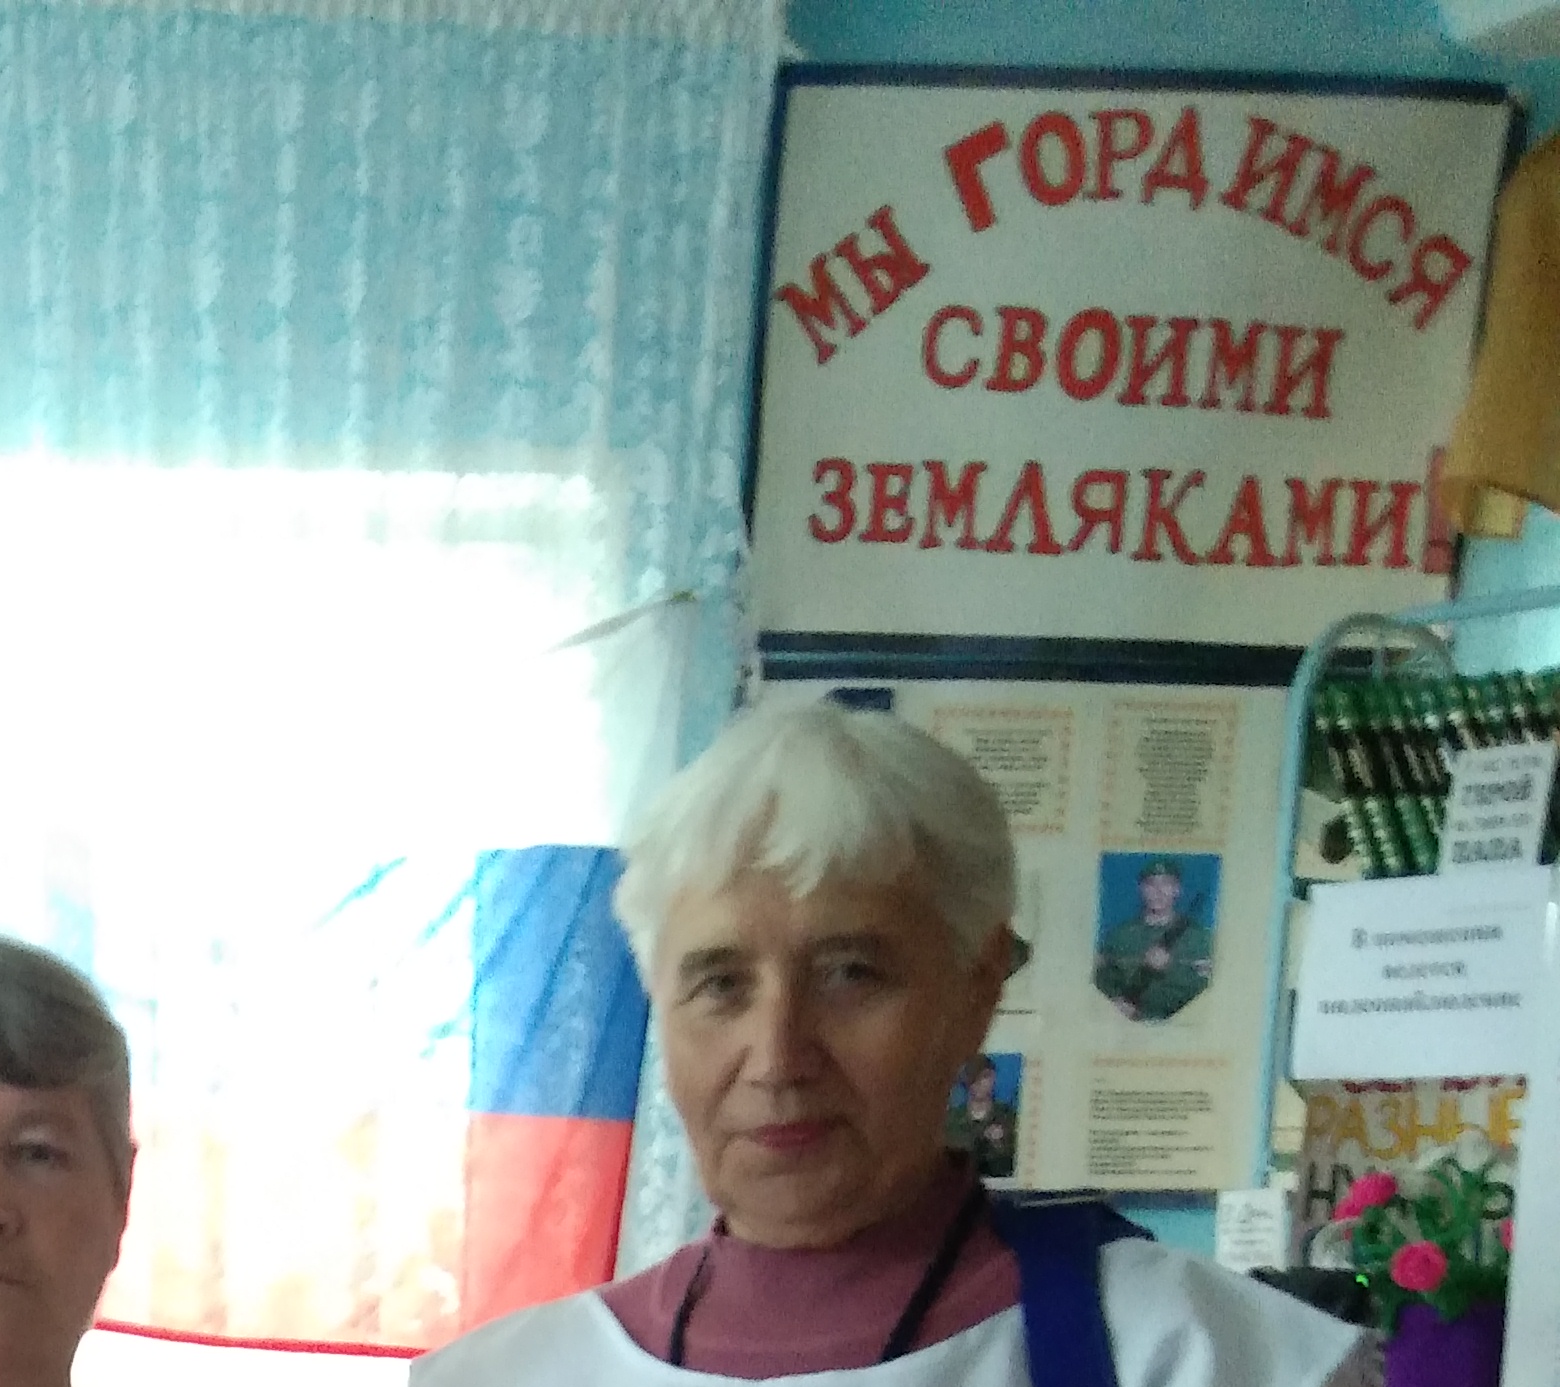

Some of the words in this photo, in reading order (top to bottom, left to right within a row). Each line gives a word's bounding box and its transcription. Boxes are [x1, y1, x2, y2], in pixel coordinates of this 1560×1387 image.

[773, 205, 931, 366] МЫ
[943, 105, 1473, 332] ГОРДИМСЯ
[920, 303, 1345, 419] СВОИМИ
